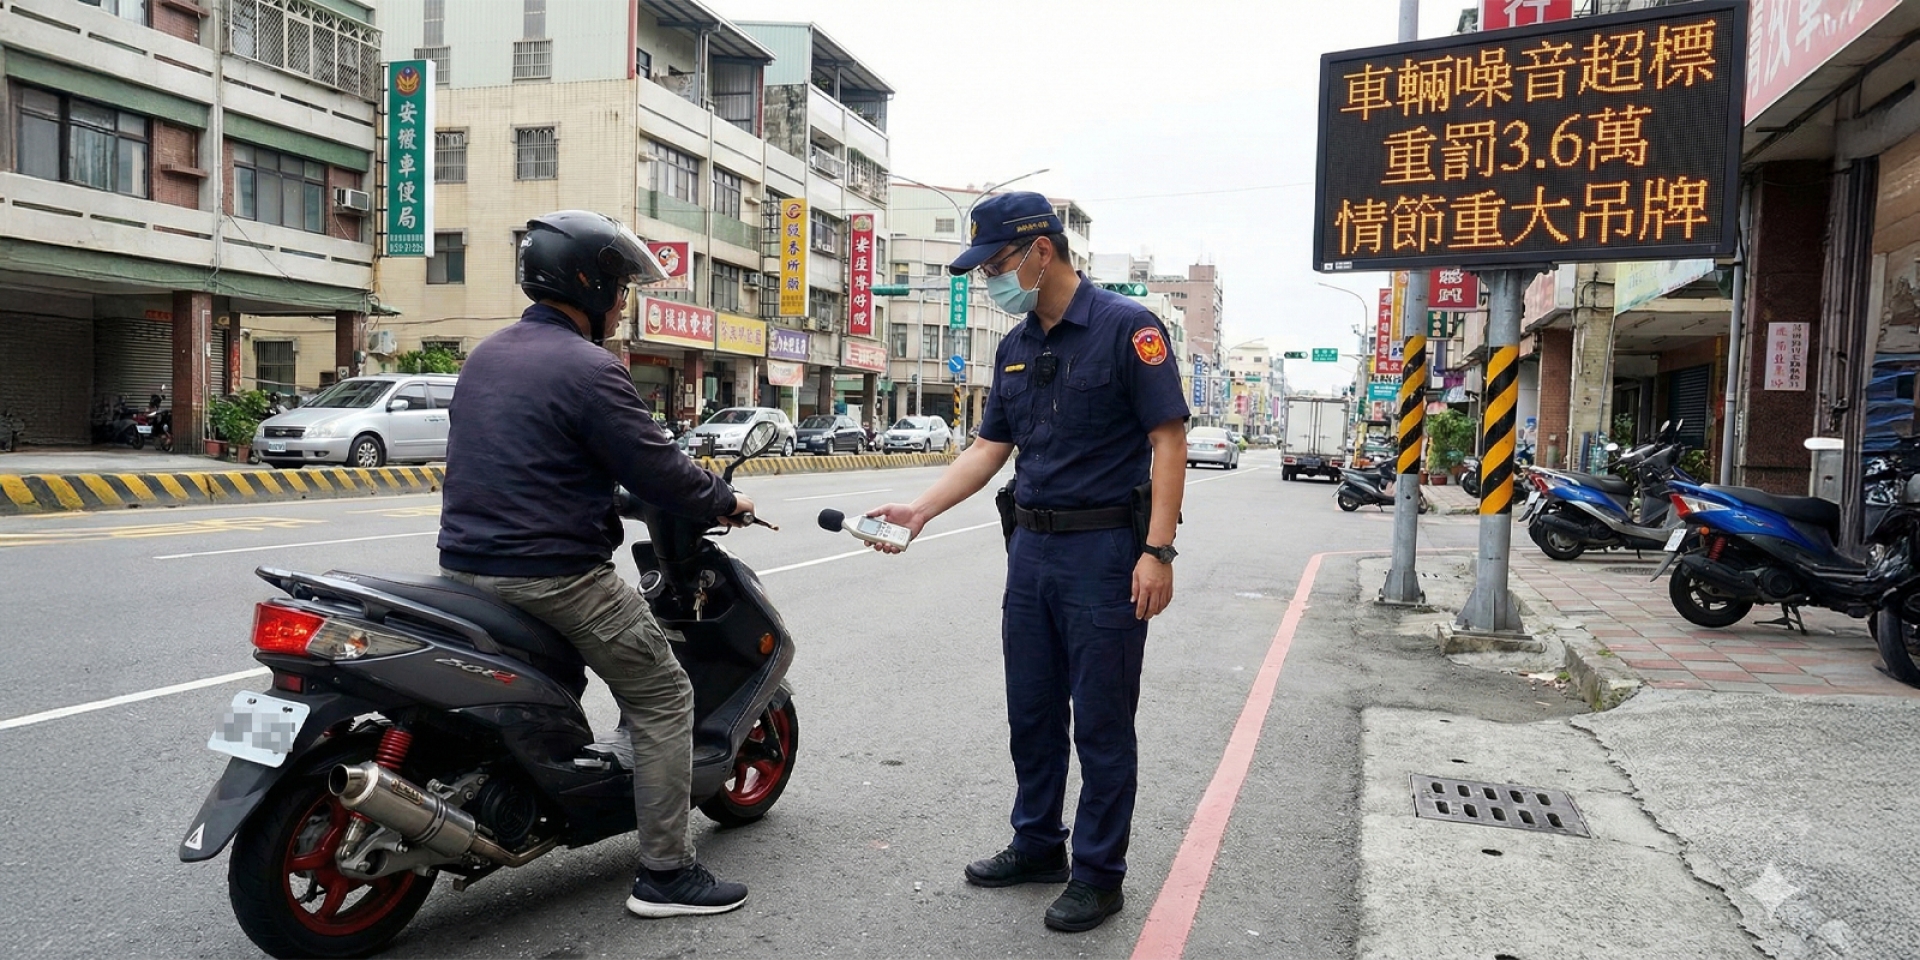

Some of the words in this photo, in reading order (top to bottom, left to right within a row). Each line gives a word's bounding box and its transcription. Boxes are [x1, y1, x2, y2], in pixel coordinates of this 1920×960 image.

[1340, 19, 1717, 121] 車輛噪音超標
[1382, 105, 1652, 185] 重罰3.6萬
[1335, 176, 1709, 255] 情節重大吊牌
